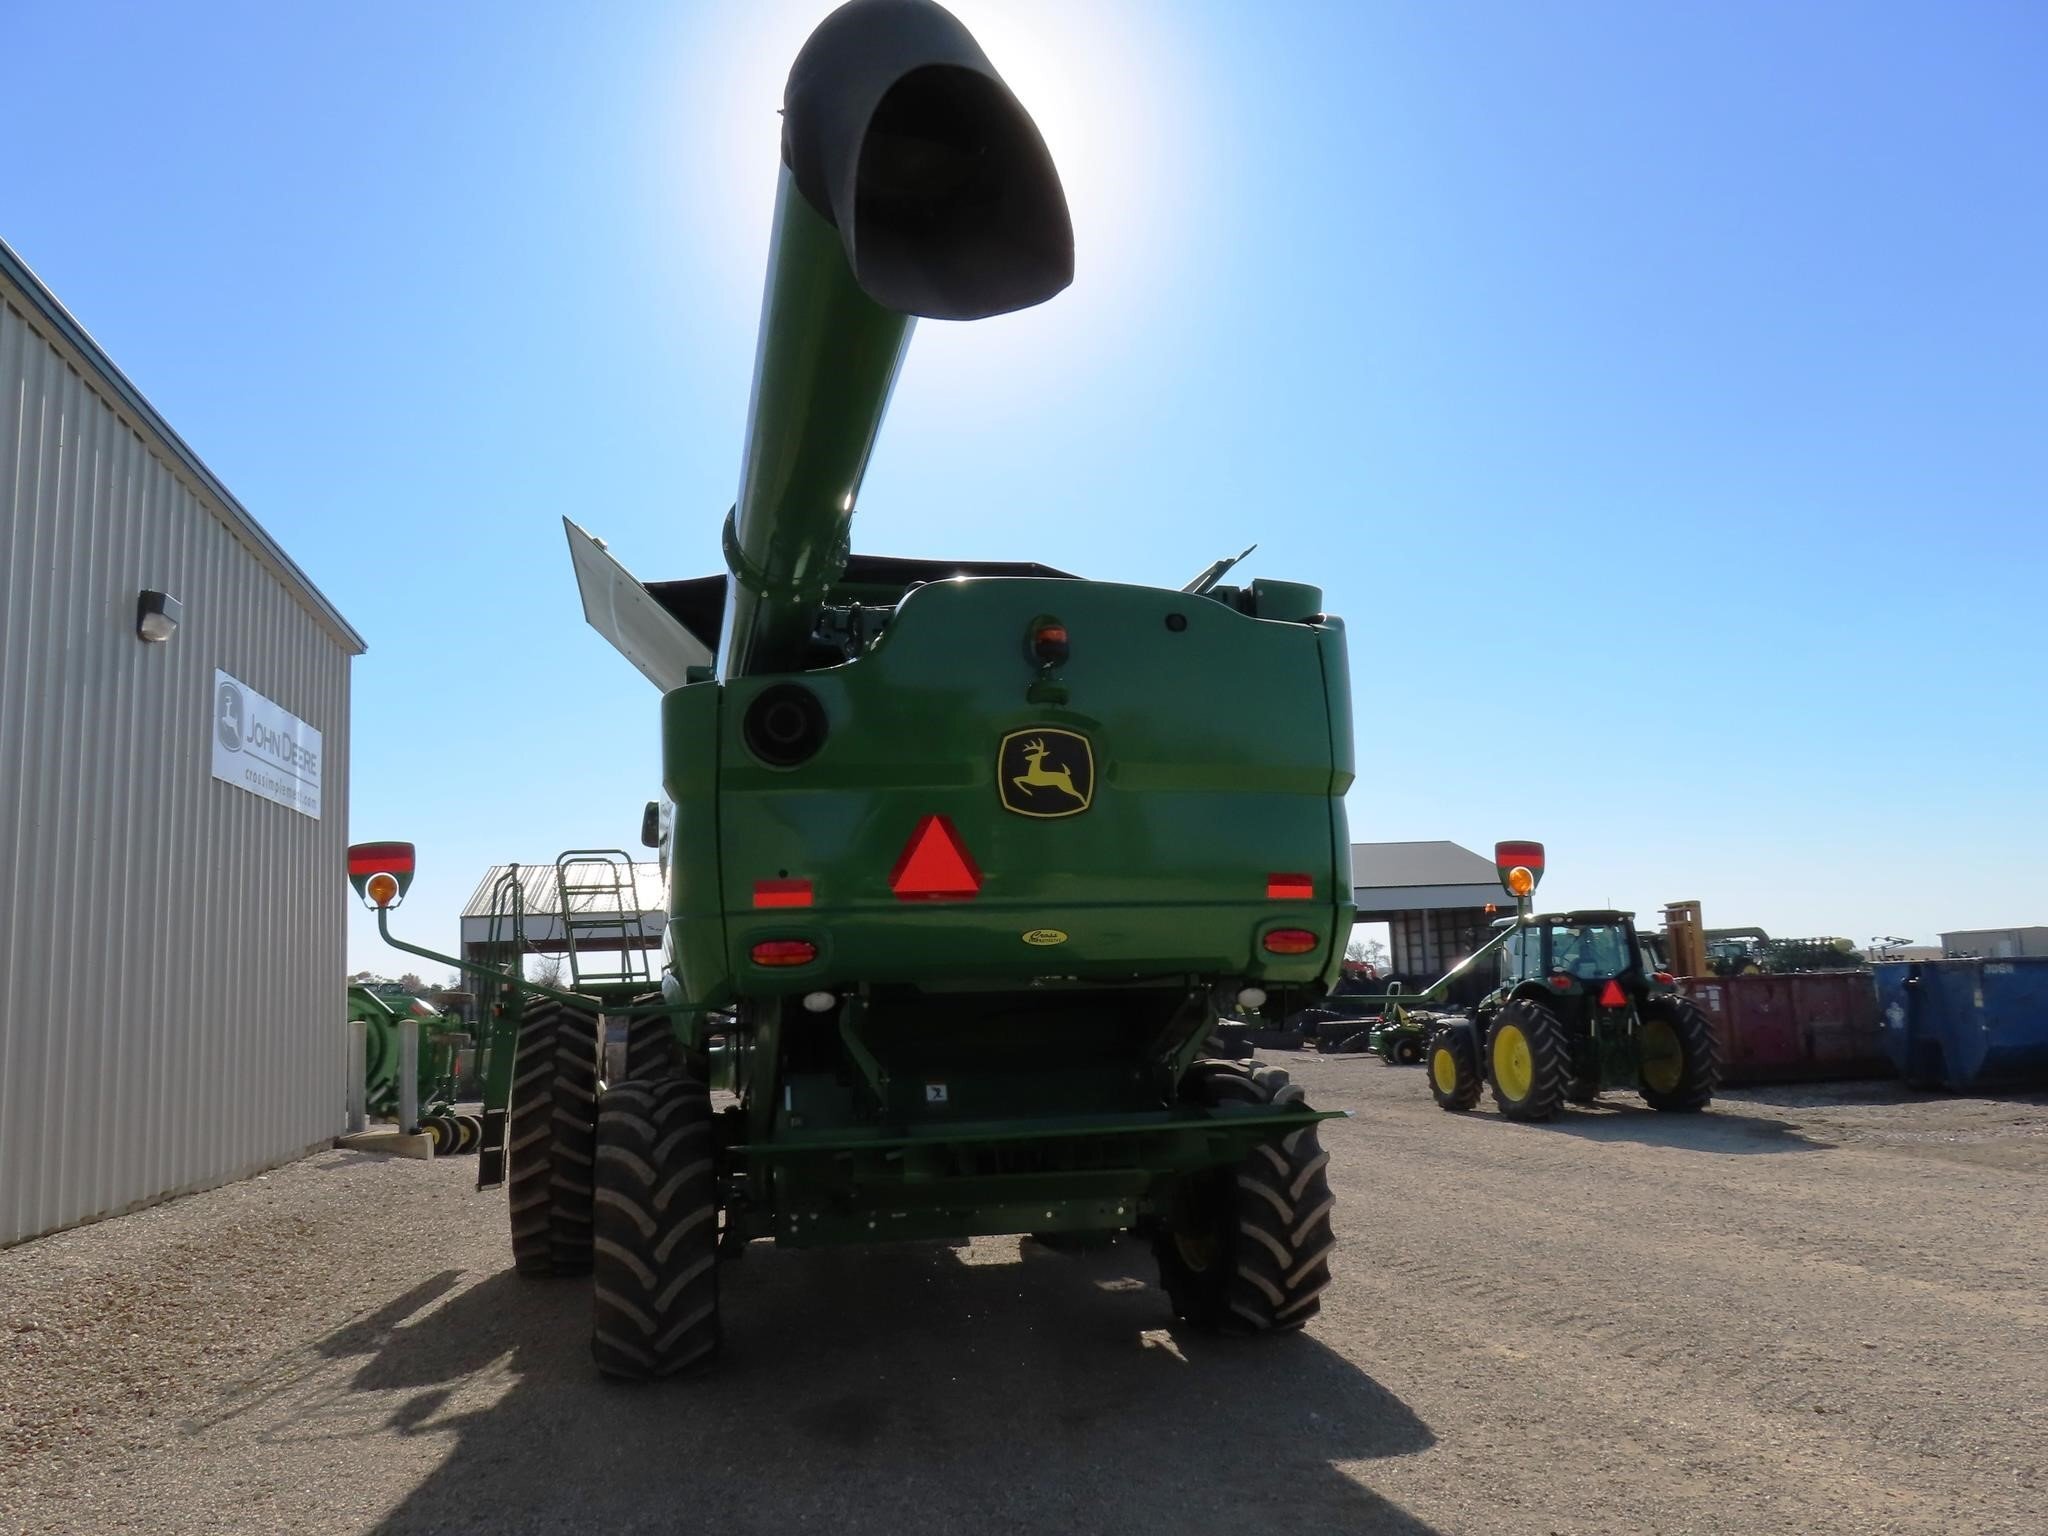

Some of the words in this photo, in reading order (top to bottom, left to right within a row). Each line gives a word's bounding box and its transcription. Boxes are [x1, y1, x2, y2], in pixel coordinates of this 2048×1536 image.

[246, 713, 280, 758] JOHN
[282, 731, 317, 776] DEERE
[245, 767, 317, 809] crossimpleme.com
